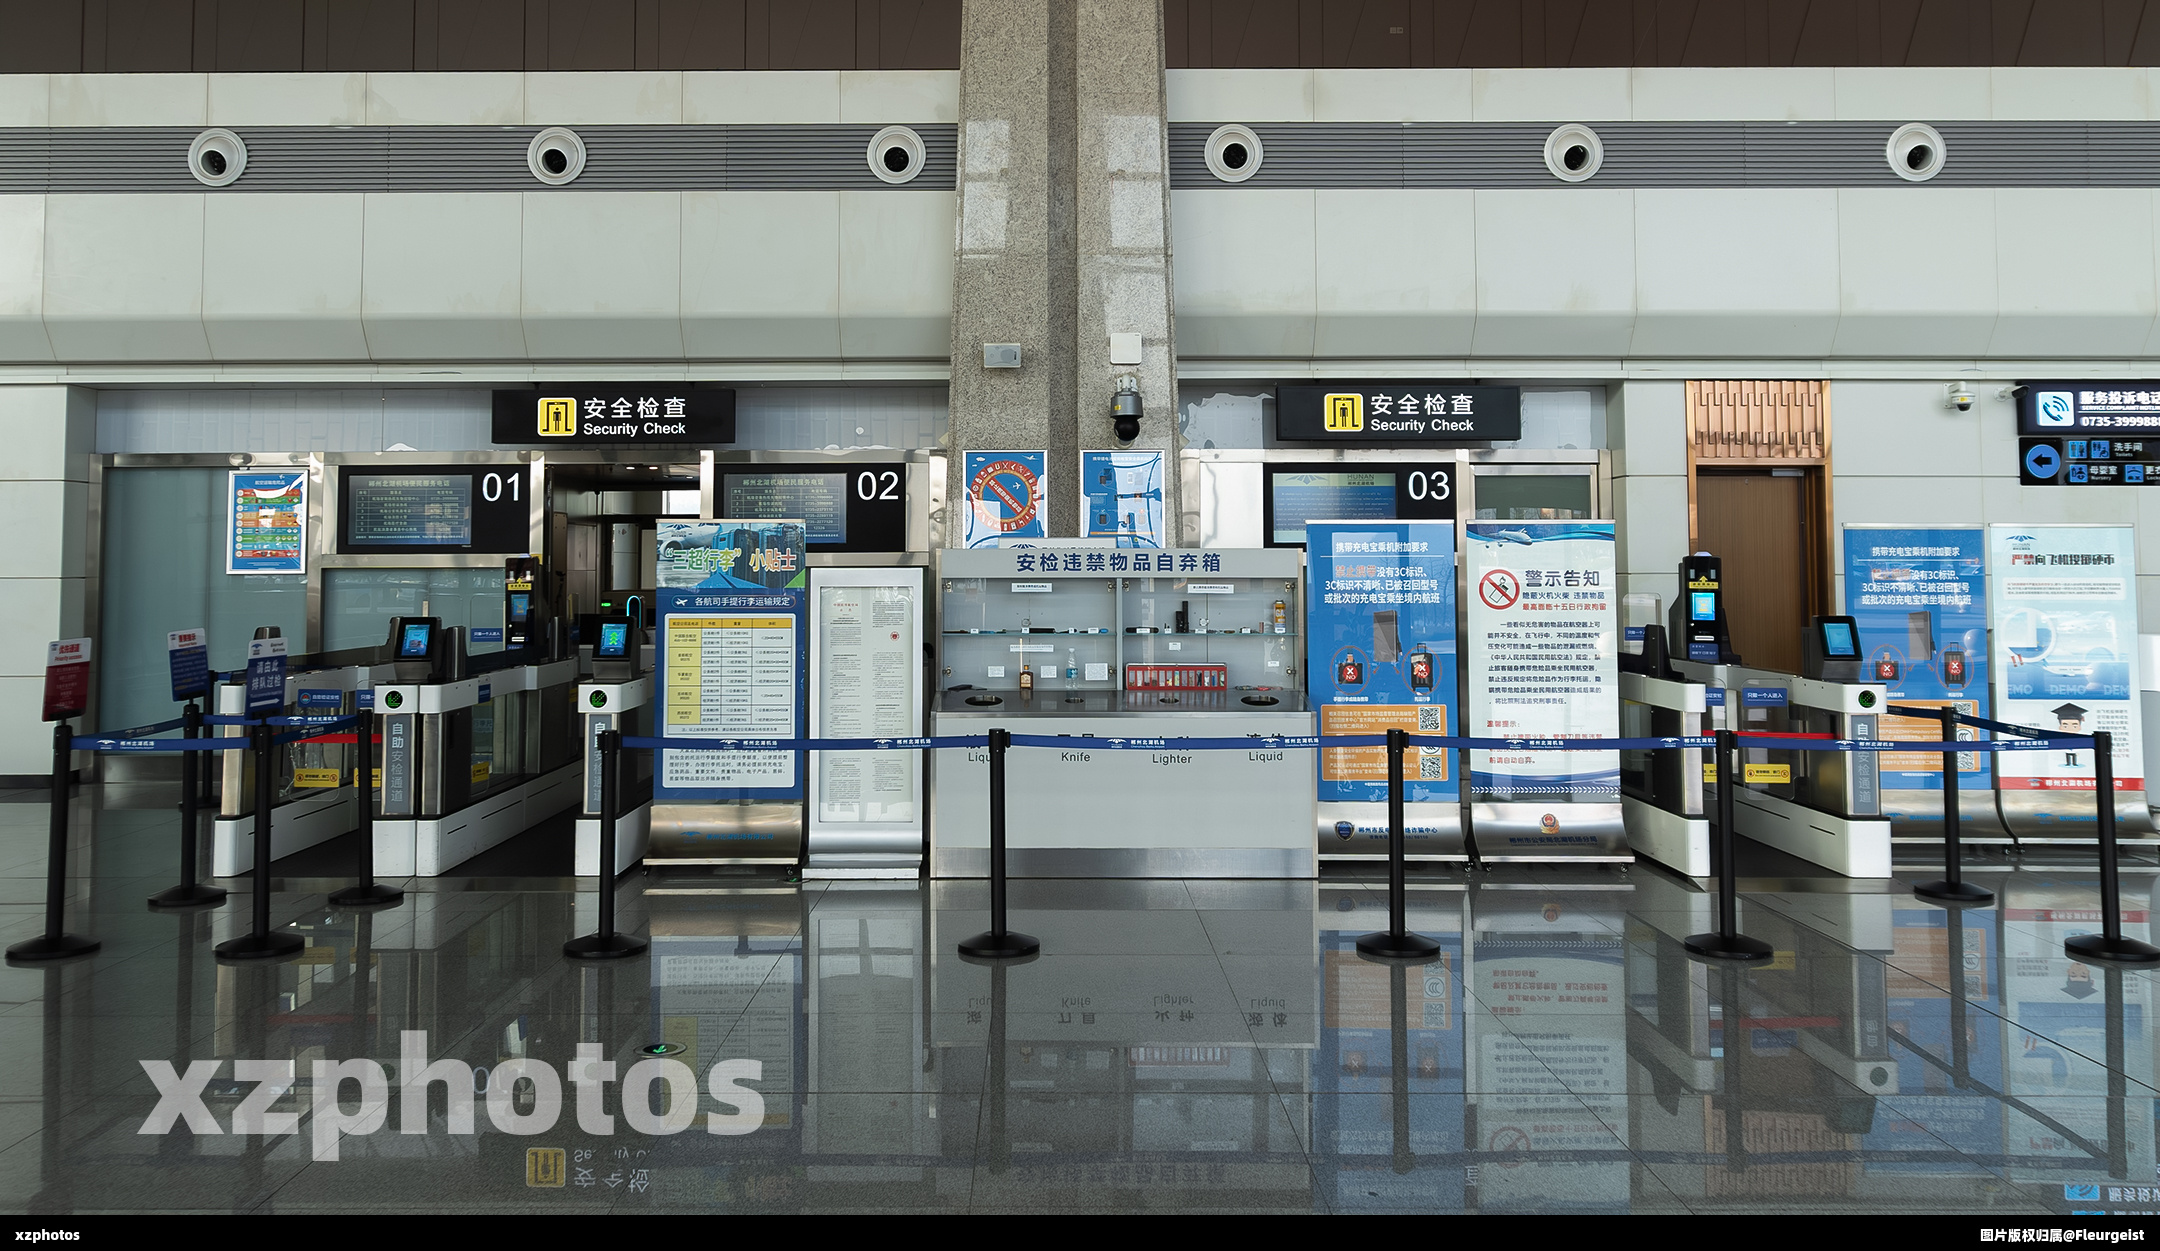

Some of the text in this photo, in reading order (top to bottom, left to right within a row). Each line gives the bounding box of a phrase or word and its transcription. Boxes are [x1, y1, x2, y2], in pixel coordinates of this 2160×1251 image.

[583, 397, 687, 419] 安全检查
[1371, 393, 1475, 416] 安全检查
[1371, 418, 1475, 434] Security Check
[2080, 416, 2160, 427] 0735-399988
[583, 422, 687, 437] Security Check
[2113, 442, 2143, 452] 洗手间
[2090, 465, 2118, 475] 母婴室
[482, 472, 520, 502] 01
[743, 478, 824, 487] 郴州北湖机场便民服务电话
[857, 471, 899, 501] 02
[1408, 470, 1450, 501] 03
[1335, 541, 1429, 553] 携带充电宝乘机附加要求
[1872, 546, 1960, 557] 携带充电宝乘机附加要求
[666, 548, 797, 572] “三超行李” 小贴士
[1016, 553, 1222, 573] 安检违禁物品自弃箱
[2012, 554, 2115, 565] 严禁向飞机投掷硬币
[1335, 565, 1428, 578] 禁止携带没有3C标识、
[1525, 569, 1600, 587] 警示告知
[1325, 580, 1438, 591] 3C标识不清晰、已被召回型号
[1862, 582, 1970, 593] 3C标识不清晰、已被召回型号
[1324, 592, 1440, 604] 或批次的充电宝乘坐境内航班
[1573, 591, 1605, 600] 违禁物品
[1861, 594, 1972, 605] 或批次的充电宝乘坐境内航班
[694, 597, 790, 607] 各航司手提行李运输规定
[1522, 603, 1607, 611] 最高面临十五日行政拘留
[257, 659, 279, 674] 请由此
[251, 674, 281, 691] 排队过检
[2049, 684, 2087, 695] DEMO
[2103, 684, 2130, 695] DEM
[391, 722, 404, 802] 自助安检通道
[968, 752, 991, 764] Liqu
[1061, 751, 1091, 762] Knife
[1152, 753, 1193, 766] Lighter
[1249, 751, 1283, 763] Liquid
[2045, 779, 2123, 787] 郴州北湖机场司
